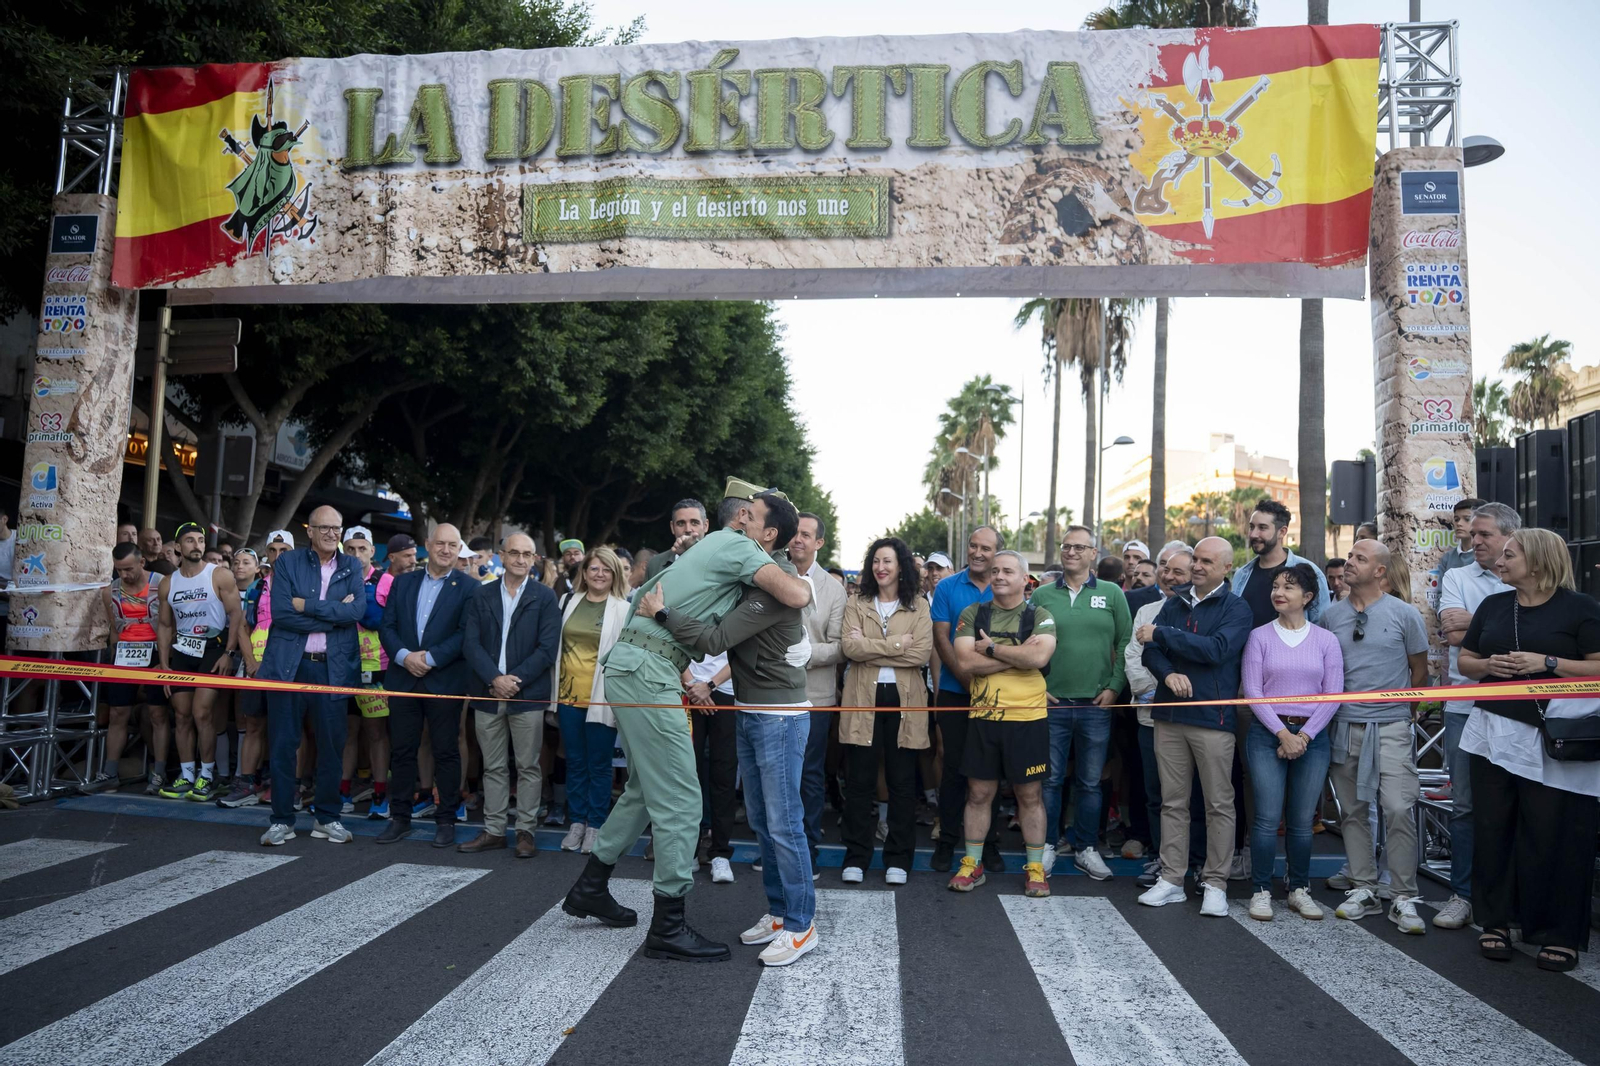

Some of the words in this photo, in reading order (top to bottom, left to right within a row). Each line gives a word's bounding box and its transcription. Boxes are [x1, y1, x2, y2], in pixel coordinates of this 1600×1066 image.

[343, 83, 462, 169] LA
[484, 48, 1103, 162] DESÉRTICA
[559, 198, 580, 221] La
[589, 193, 641, 222] Legión
[651, 200, 661, 222] y
[672, 195, 687, 219] el
[697, 194, 767, 218] desierto
[776, 197, 807, 216] nos
[817, 197, 850, 216] une
[1407, 275, 1462, 287] RENTA
[1408, 289, 1463, 306] TODO
[44, 305, 86, 316] RENTA
[43, 317, 85, 332] TODO
[1411, 421, 1471, 435] primaflor
[28, 432, 73, 444] primaflor
[30, 501, 53, 509] Activa
[1428, 502, 1454, 510] Activ
[1417, 530, 1458, 547] unic
[19, 577, 49, 586] Fundación
[1090, 595, 1107, 608] 85
[181, 638, 202, 650] 2405
[125, 649, 147, 658] 2224
[1026, 763, 1046, 776] ARMY
